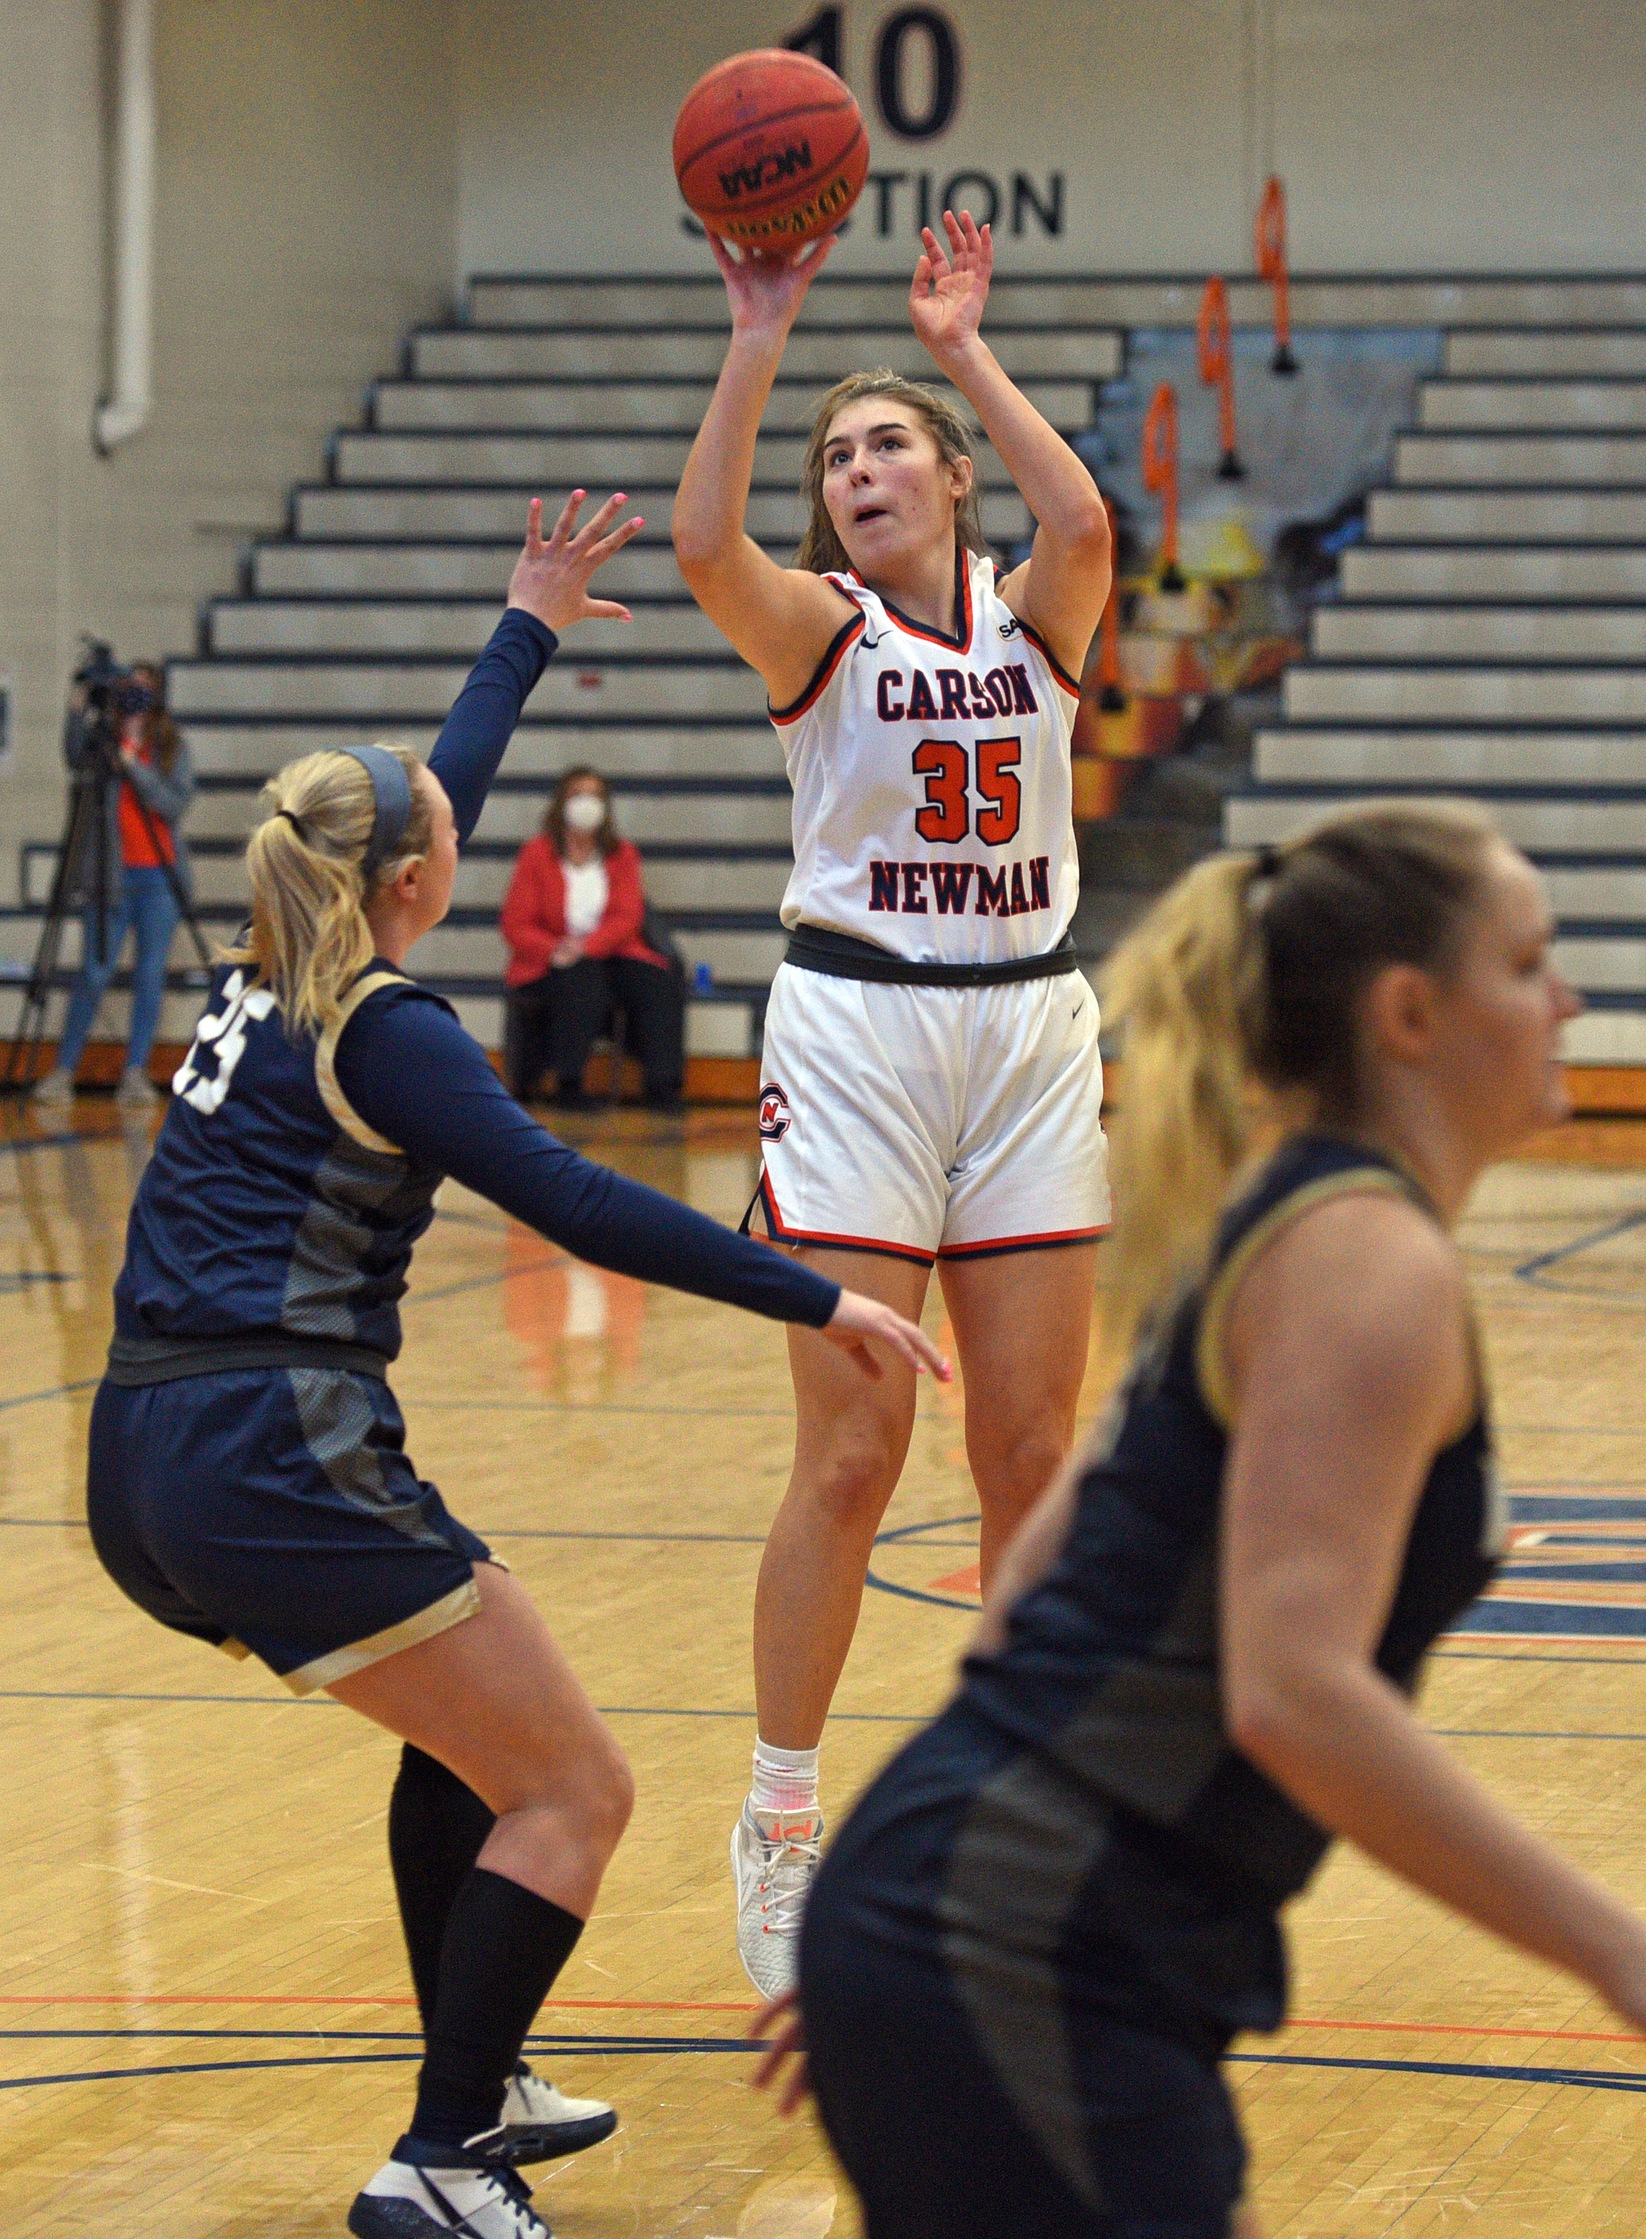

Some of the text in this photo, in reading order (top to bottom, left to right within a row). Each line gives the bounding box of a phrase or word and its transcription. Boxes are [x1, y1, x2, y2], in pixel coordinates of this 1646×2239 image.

[718, 137, 813, 198] NCAA
[877, 662, 1039, 722] CARSON
[911, 736, 1021, 847] 35
[868, 856, 1051, 918] NEWMAN
